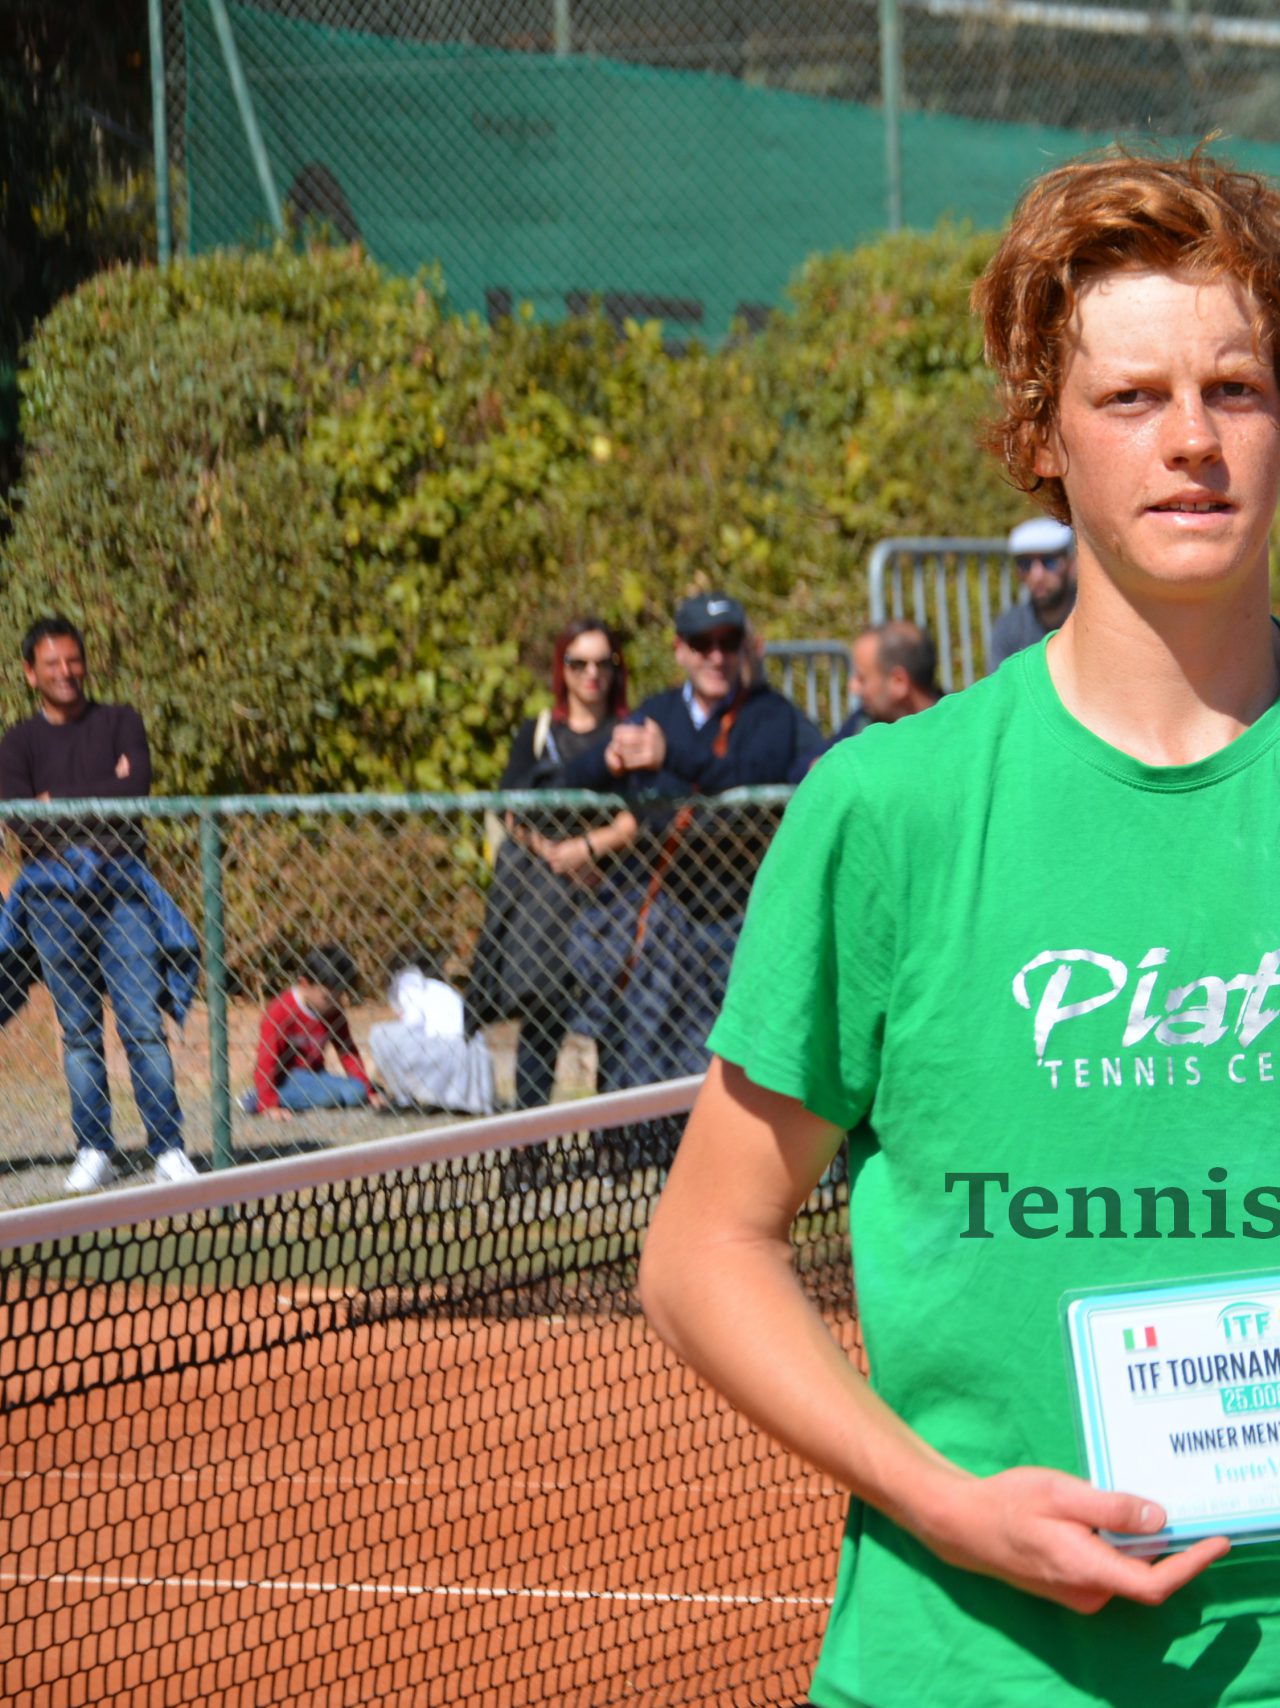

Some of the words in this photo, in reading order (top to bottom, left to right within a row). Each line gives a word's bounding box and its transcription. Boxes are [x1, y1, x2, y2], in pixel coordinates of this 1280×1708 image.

[1044, 1056, 1201, 1089] TENNIS
[1222, 1311, 1270, 1339] ITF
[1127, 1361, 1161, 1392] ITF
[1168, 1427, 1238, 1454] WINNER
